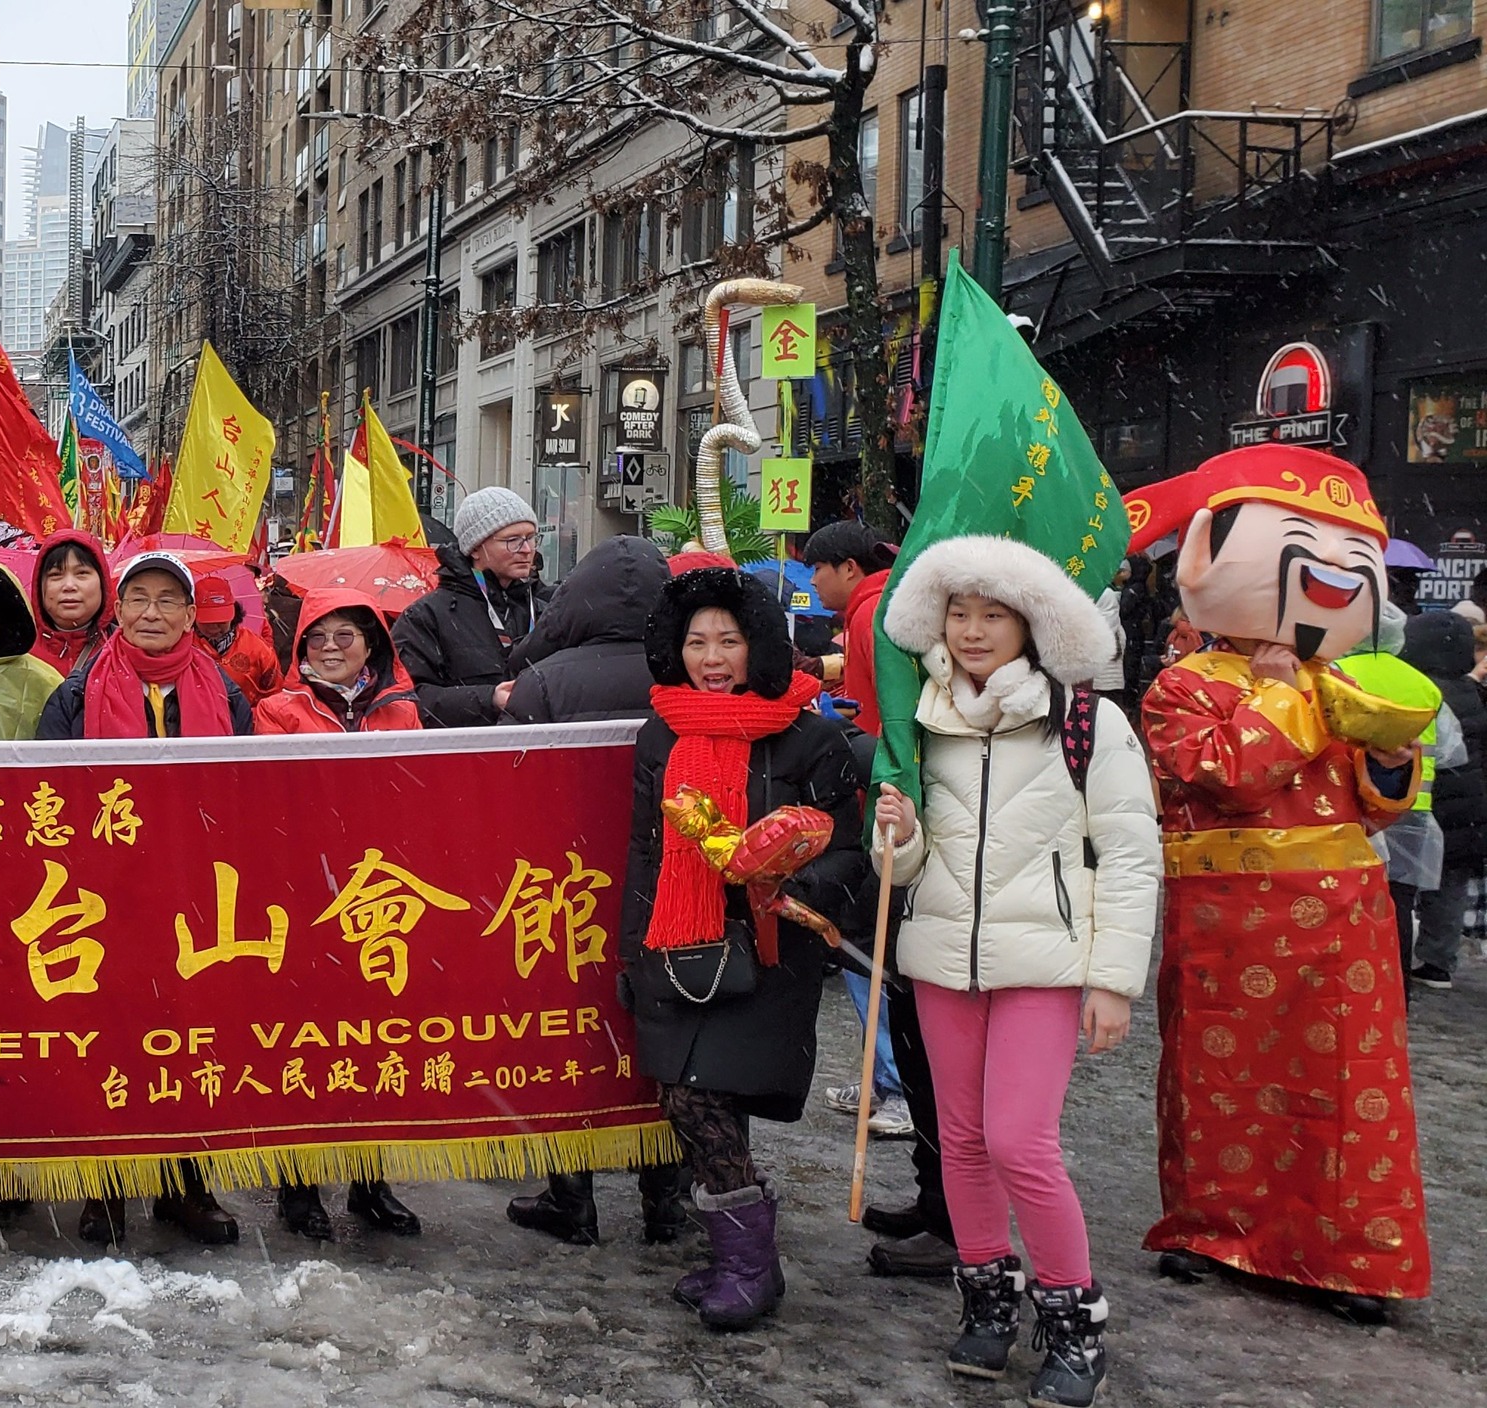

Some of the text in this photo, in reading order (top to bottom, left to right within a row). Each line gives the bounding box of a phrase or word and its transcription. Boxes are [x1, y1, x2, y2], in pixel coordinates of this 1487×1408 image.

[769, 319, 810, 362] 金
[89, 399, 118, 427] DRA
[620, 412, 660, 421] COMEDY
[624, 421, 655, 430] AFTER
[626, 430, 652, 438] DARK
[1230, 419, 1327, 445] THE PINT
[545, 439, 558, 453] HAIR
[768, 478, 803, 515] 狂
[142, 1027, 217, 1057] OF
[250, 1006, 603, 1050] VANCOUVER
